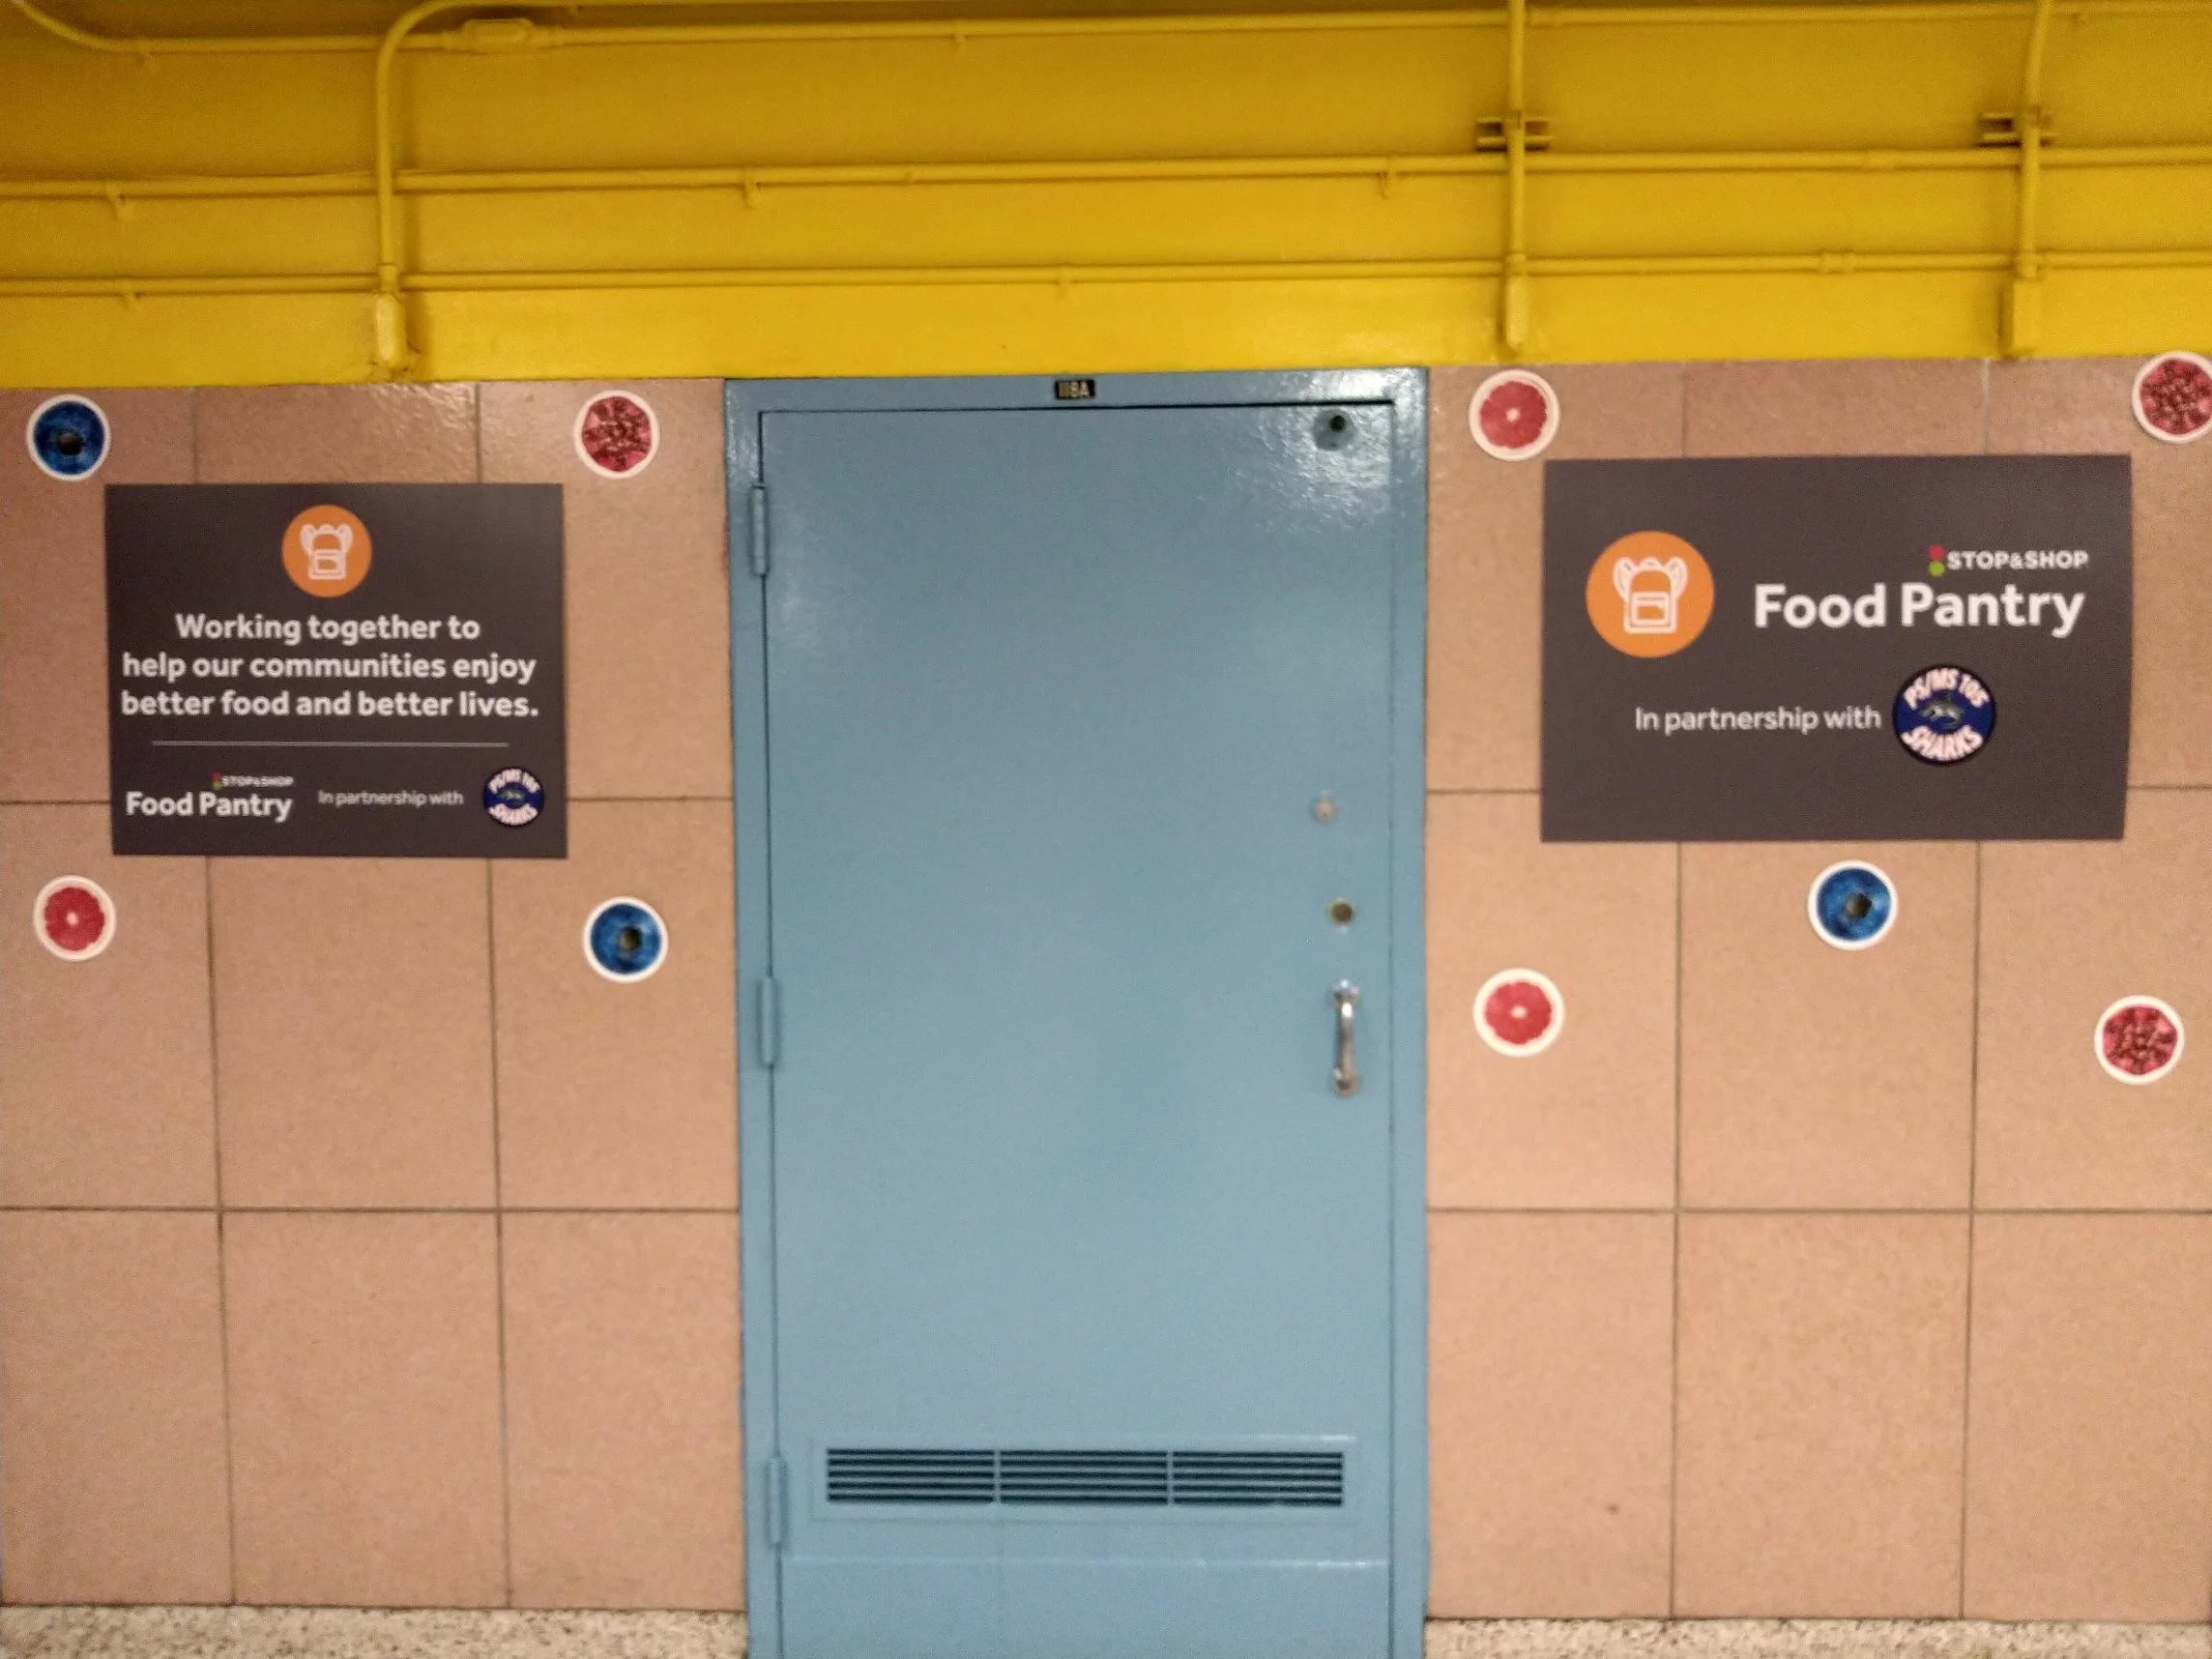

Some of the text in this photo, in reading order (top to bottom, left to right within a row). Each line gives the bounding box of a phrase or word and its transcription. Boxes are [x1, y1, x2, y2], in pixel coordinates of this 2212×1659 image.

[1947, 550, 2088, 569] STOP&SHOP
[1756, 583, 2084, 638] Food Pantry
[176, 614, 480, 646] Working together to
[122, 652, 536, 684] help our communities enjoy
[122, 689, 538, 716] better food and better lives.
[1636, 705, 1881, 736] In partnership with
[1901, 725, 1983, 761] SHARKS
[127, 792, 292, 823] Food Pantry
[318, 791, 463, 807] In partnership with
